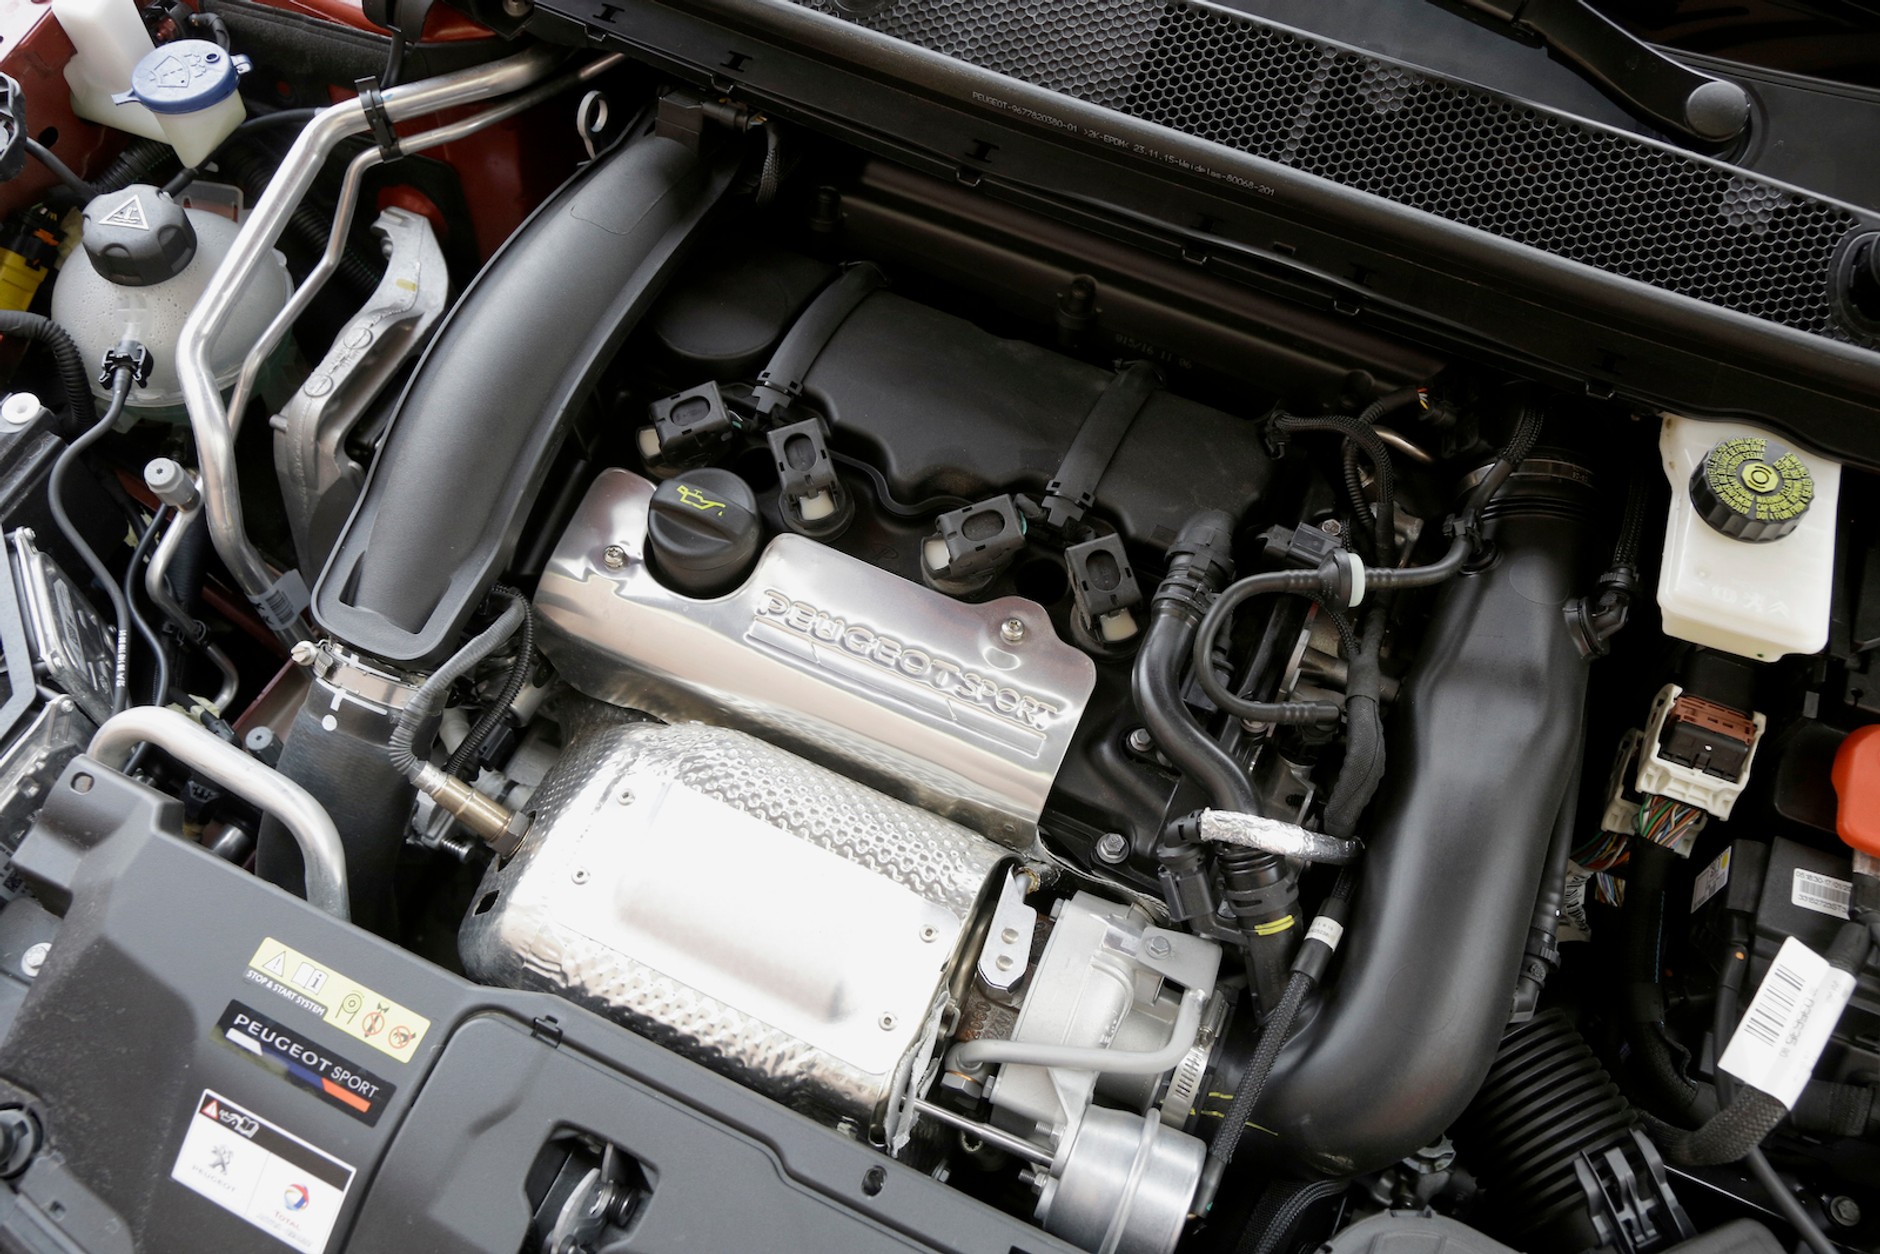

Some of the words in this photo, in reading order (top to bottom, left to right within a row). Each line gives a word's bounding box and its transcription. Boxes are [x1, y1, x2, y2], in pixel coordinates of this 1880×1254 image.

[755, 589, 960, 690] PEUGEOT
[954, 672, 1059, 730] SPORT
[246, 969, 268, 984] STOP
[272, 983, 298, 1001] START
[295, 995, 326, 1017] SYSTEM
[233, 1013, 332, 1072] PEUGEOT
[330, 1066, 379, 1098] SPORT
